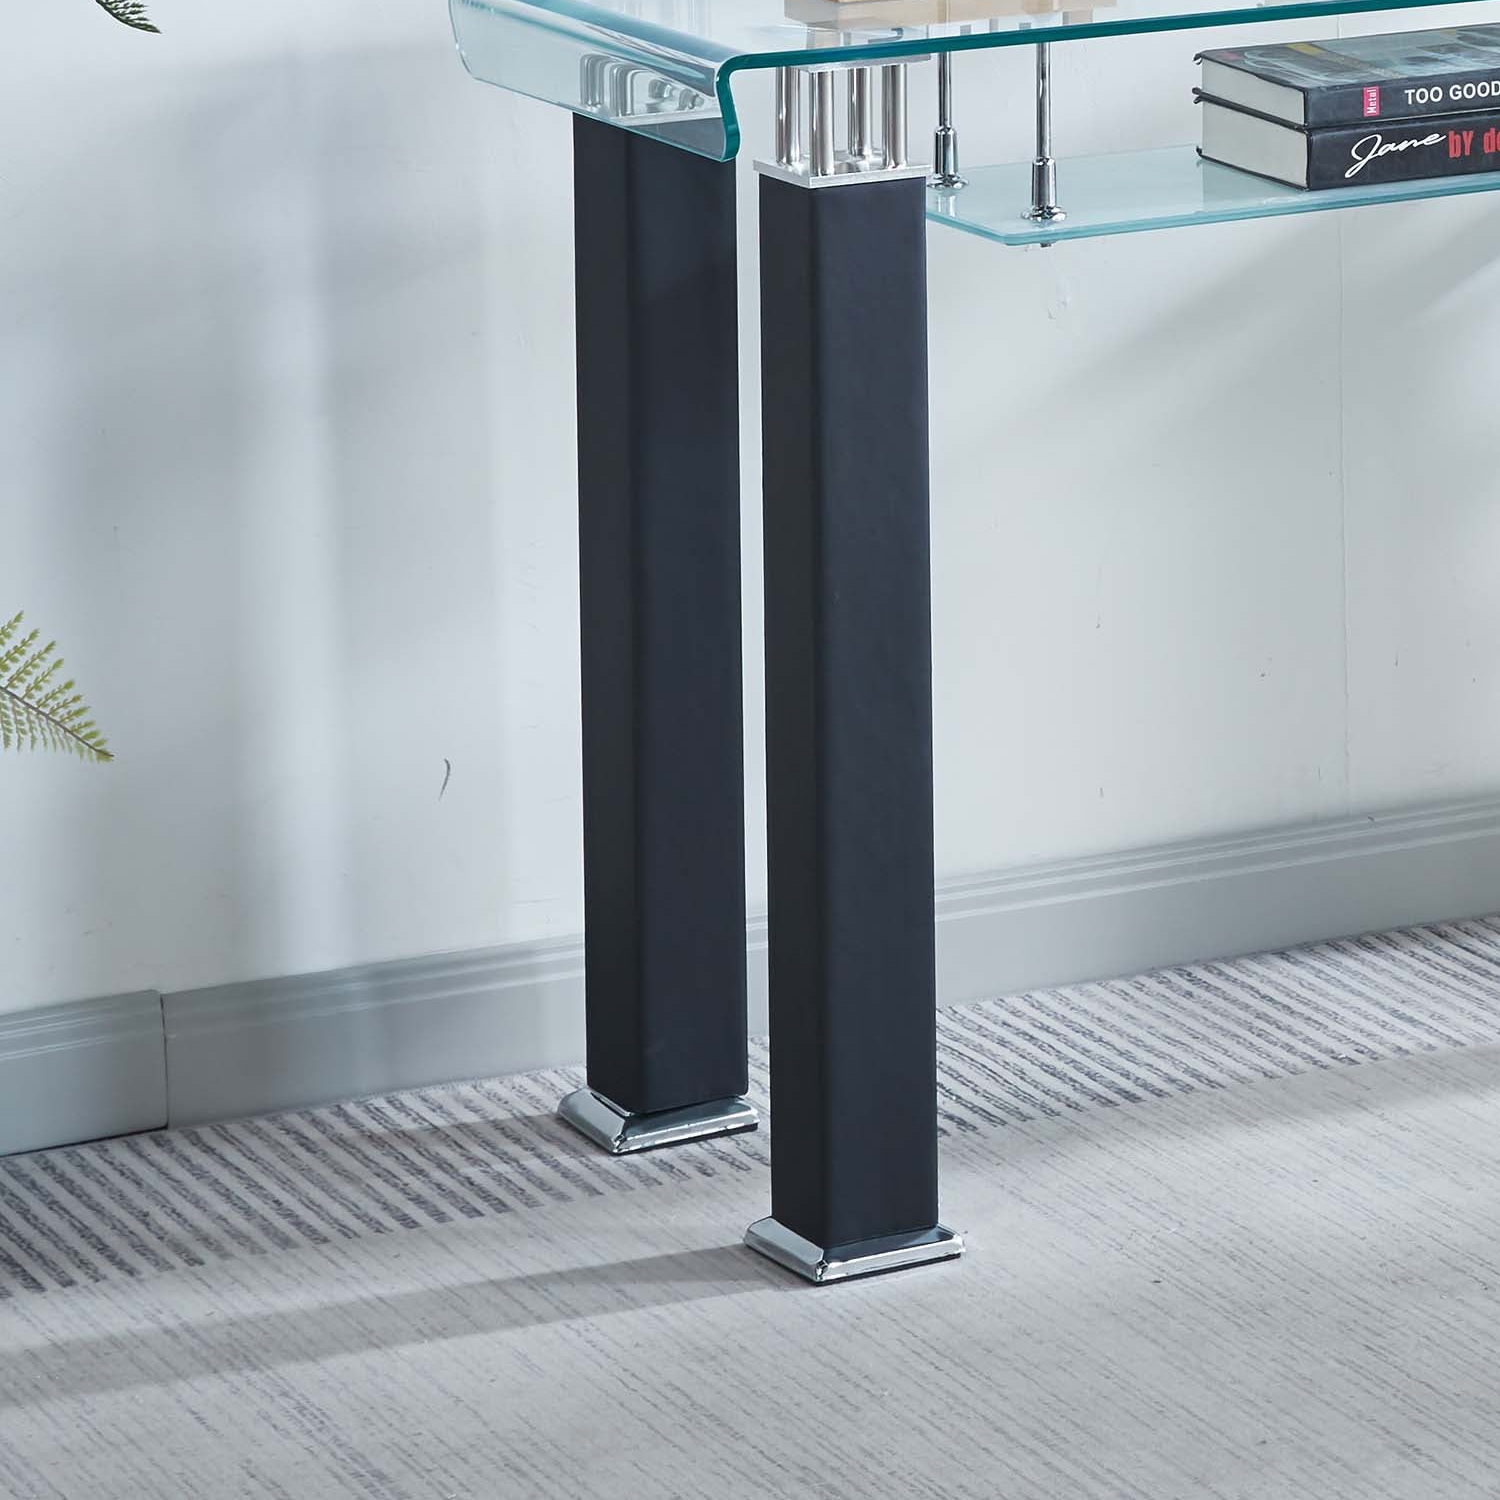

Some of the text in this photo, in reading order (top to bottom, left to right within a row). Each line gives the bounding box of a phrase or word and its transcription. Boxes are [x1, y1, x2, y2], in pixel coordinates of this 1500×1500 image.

[1366, 87, 1378, 115] Metal
[1404, 86, 1443, 105] TOO
[1344, 133, 1447, 179] Jane
